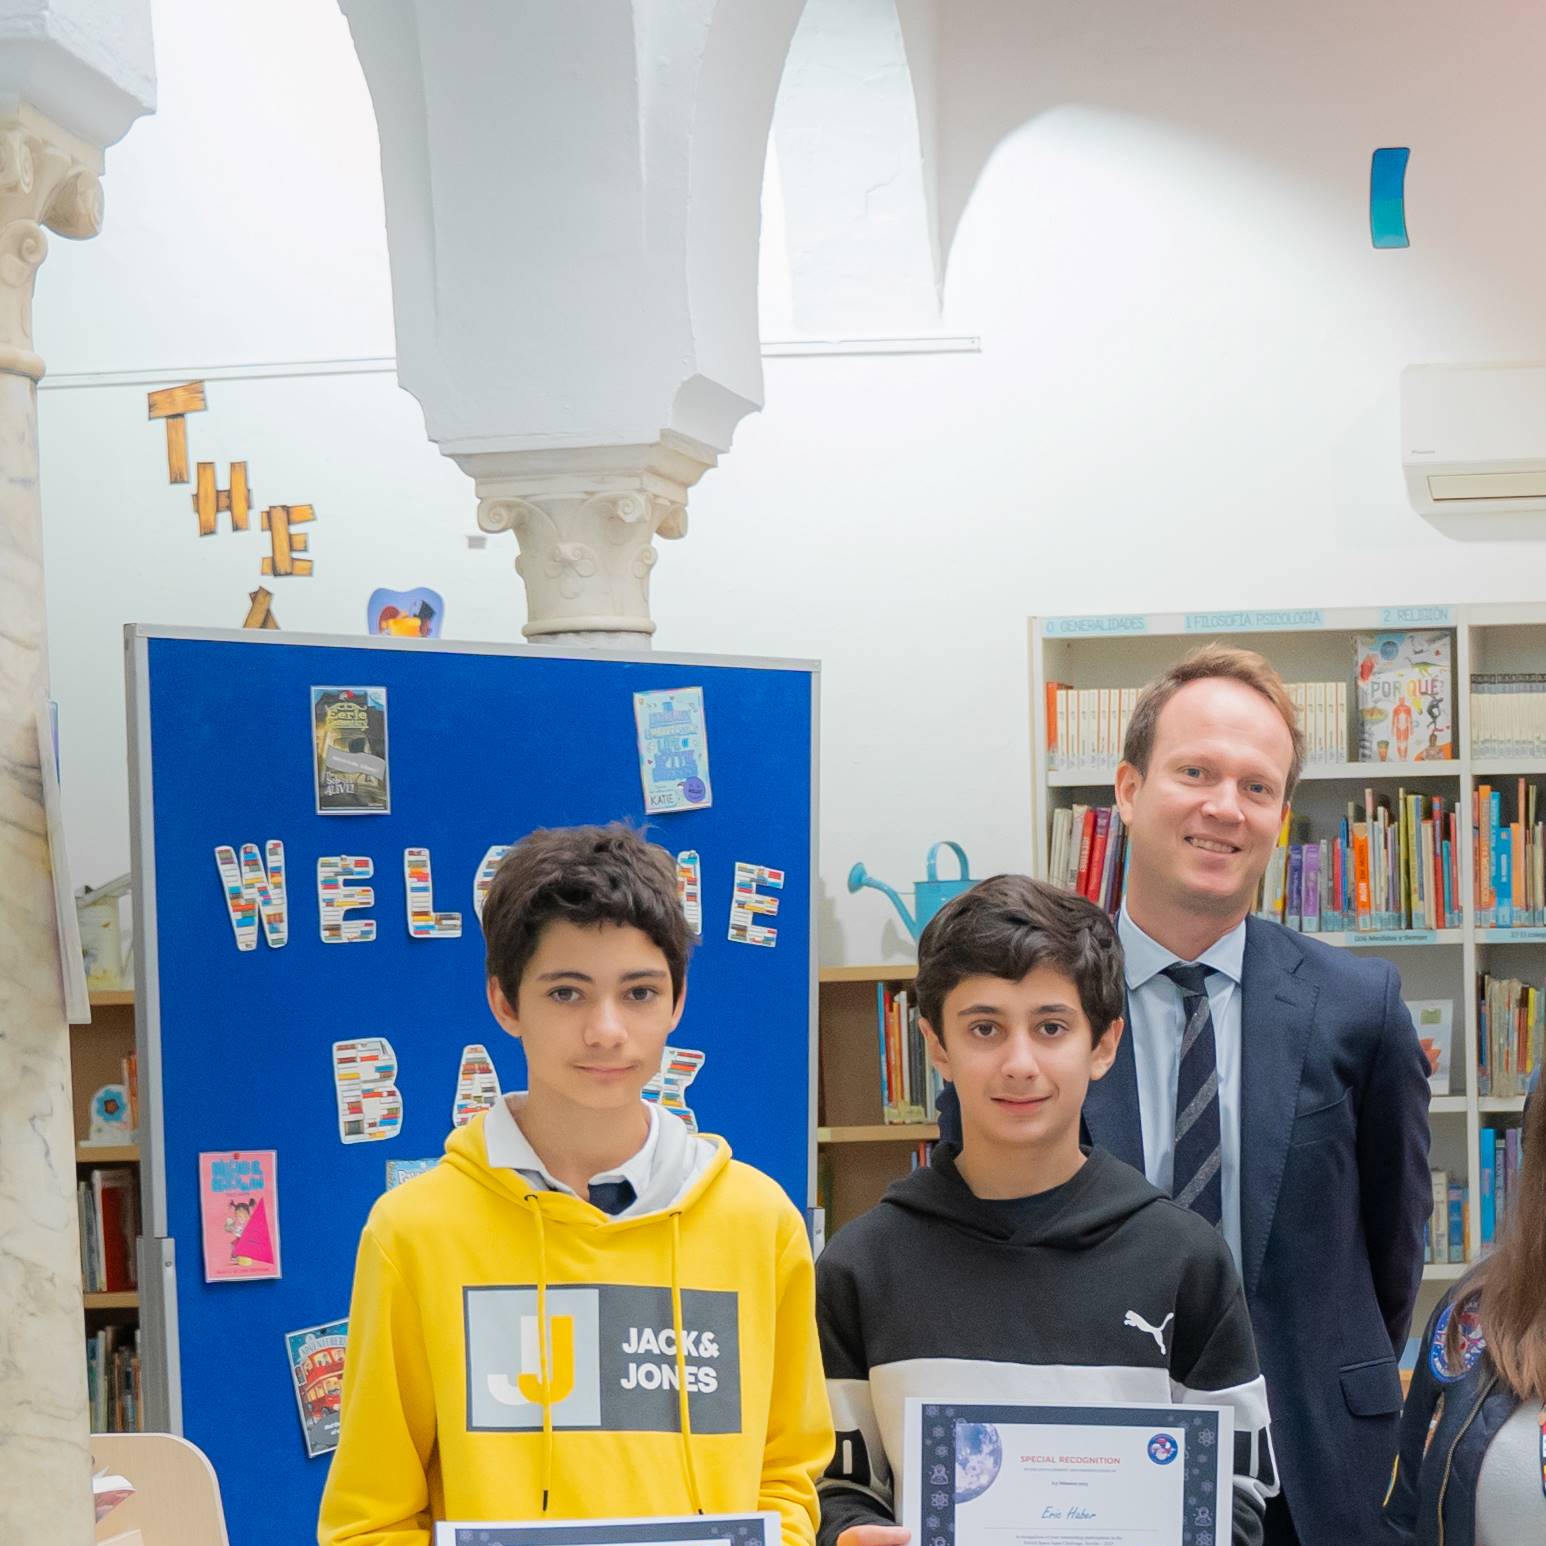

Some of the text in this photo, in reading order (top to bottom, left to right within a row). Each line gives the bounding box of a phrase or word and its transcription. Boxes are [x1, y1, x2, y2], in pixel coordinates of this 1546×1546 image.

[147, 380, 318, 577] THE
[620, 1363, 718, 1394] JONES
[1020, 1455, 1121, 1465] SPECIAL RECOGNITION
